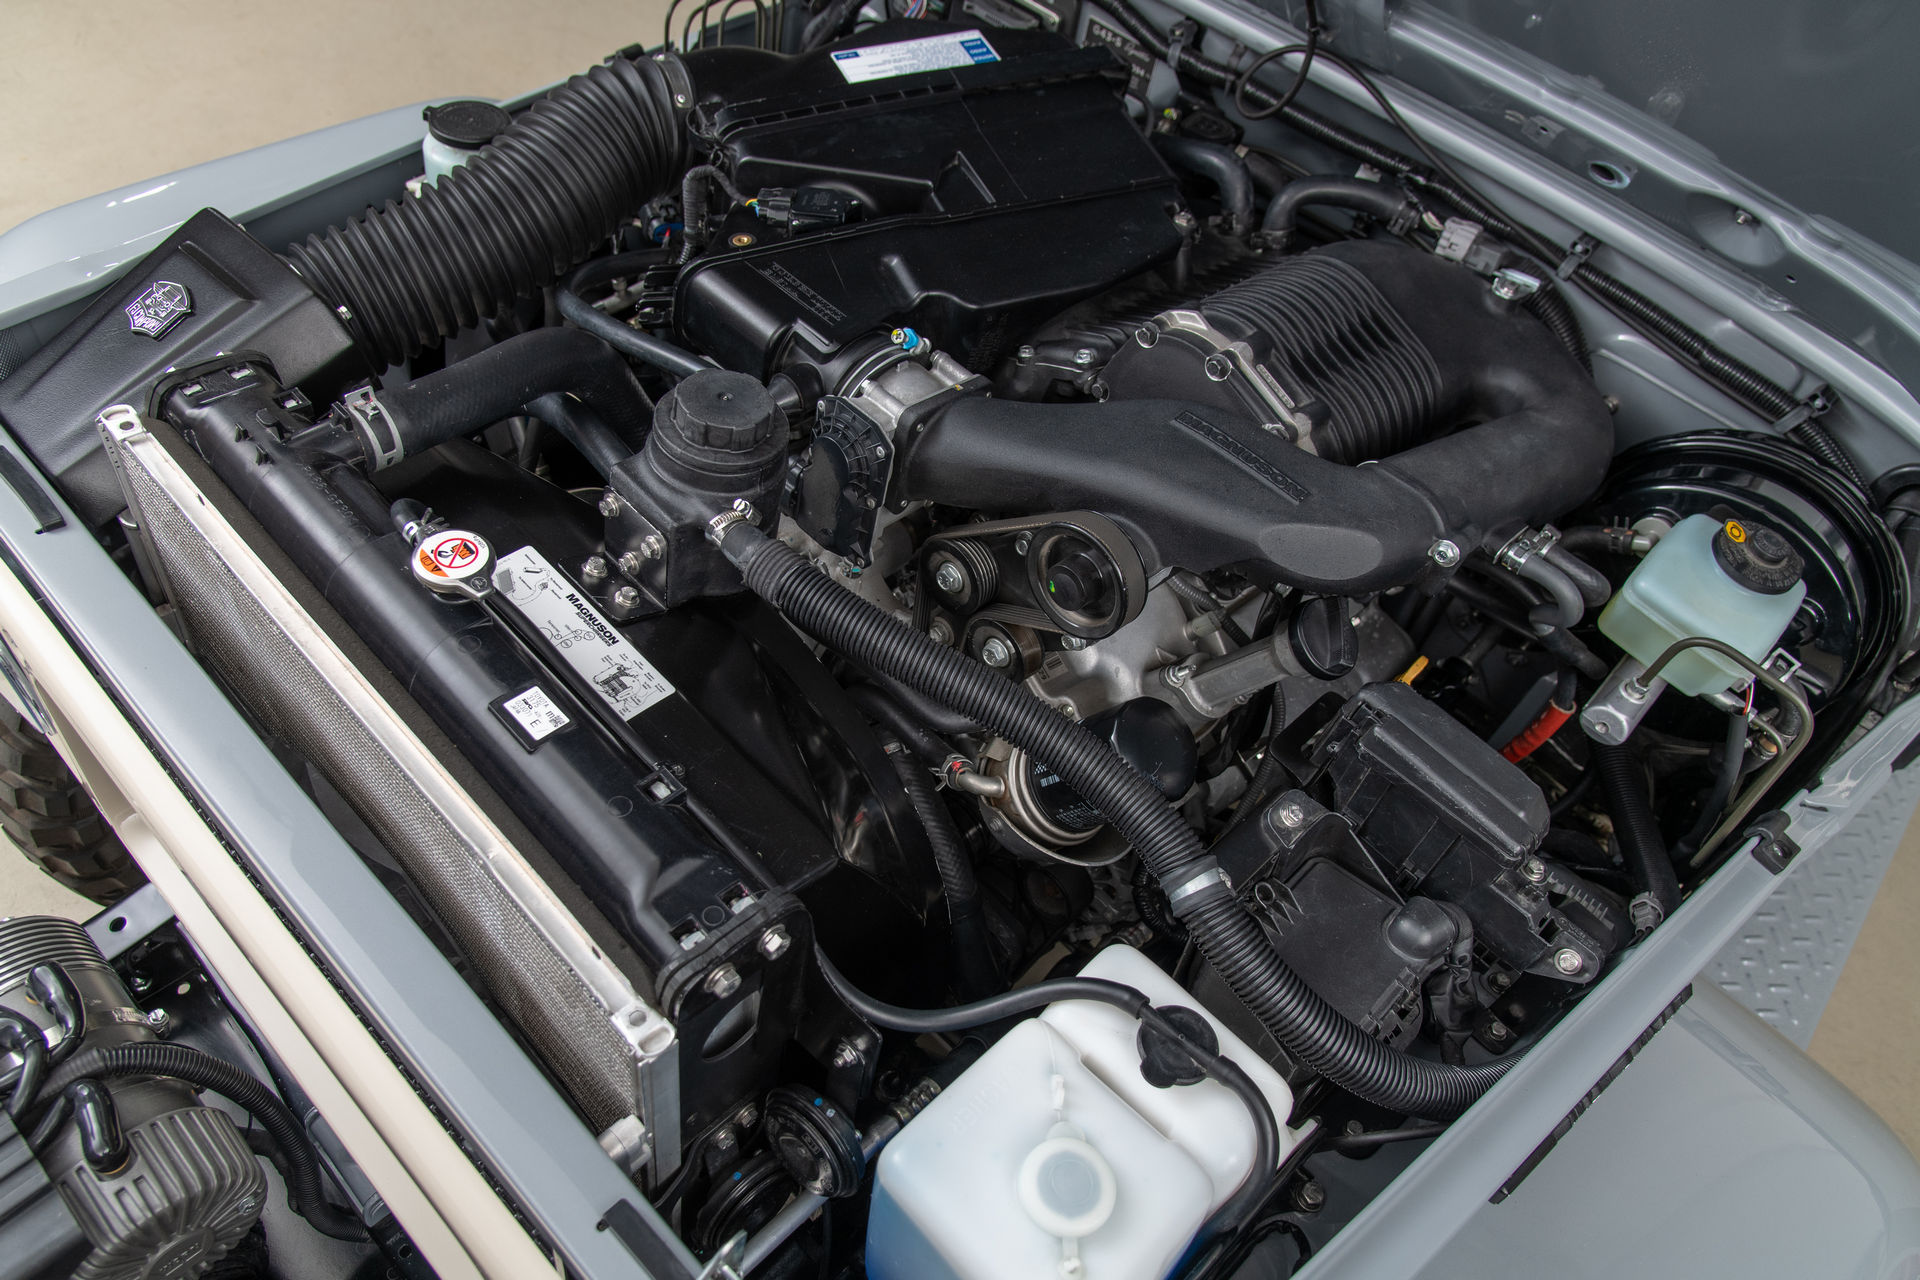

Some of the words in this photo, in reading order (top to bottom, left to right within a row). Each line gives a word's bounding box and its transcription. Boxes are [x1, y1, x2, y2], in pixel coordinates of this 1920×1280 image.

[1180, 413, 1308, 502] MAGNUSON
[566, 593, 620, 646] MAGNUSON
[575, 611, 613, 647] SUPERCHARGERS
[533, 690, 550, 708] TOYOTA
